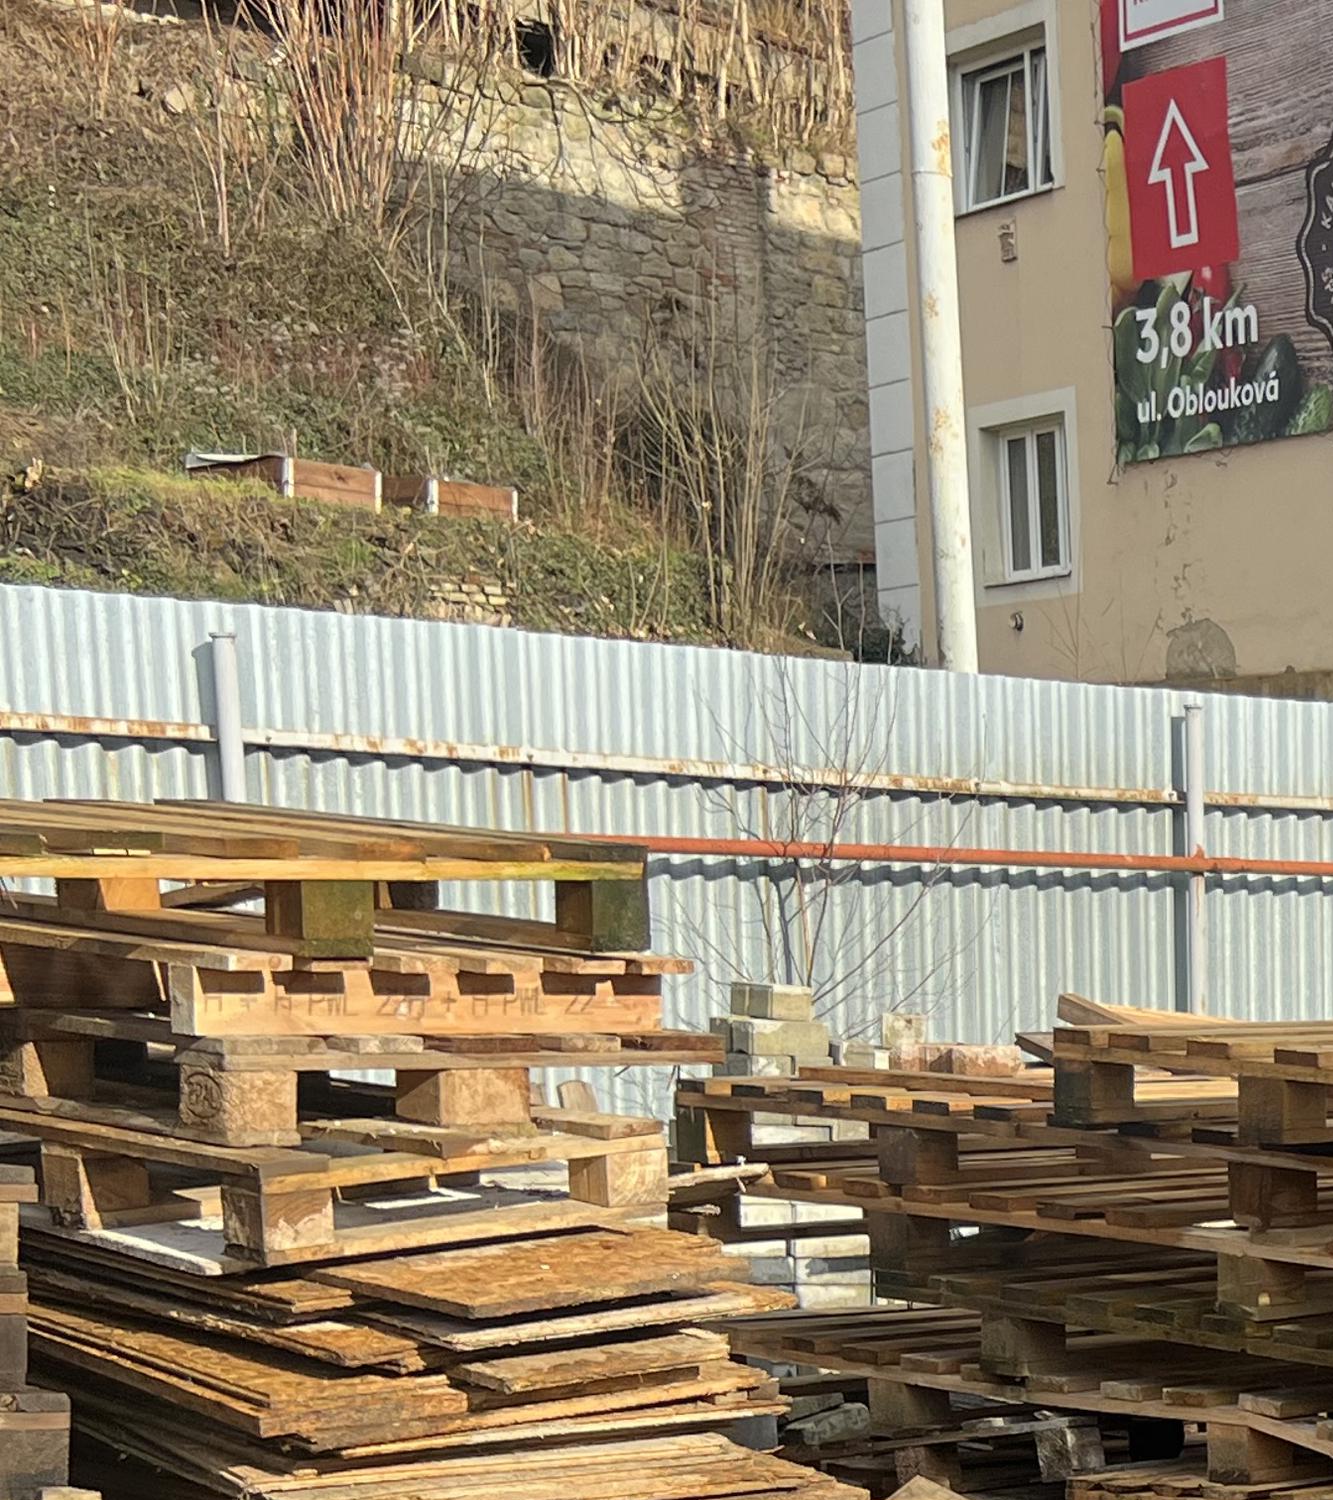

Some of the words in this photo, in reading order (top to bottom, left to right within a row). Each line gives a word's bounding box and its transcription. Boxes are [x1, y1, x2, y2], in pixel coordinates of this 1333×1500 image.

[1135, 301, 1193, 369] 3,8
[1203, 296, 1259, 352] km
[1137, 391, 1162, 424] ul.
[1167, 371, 1280, 419] Oblouková
